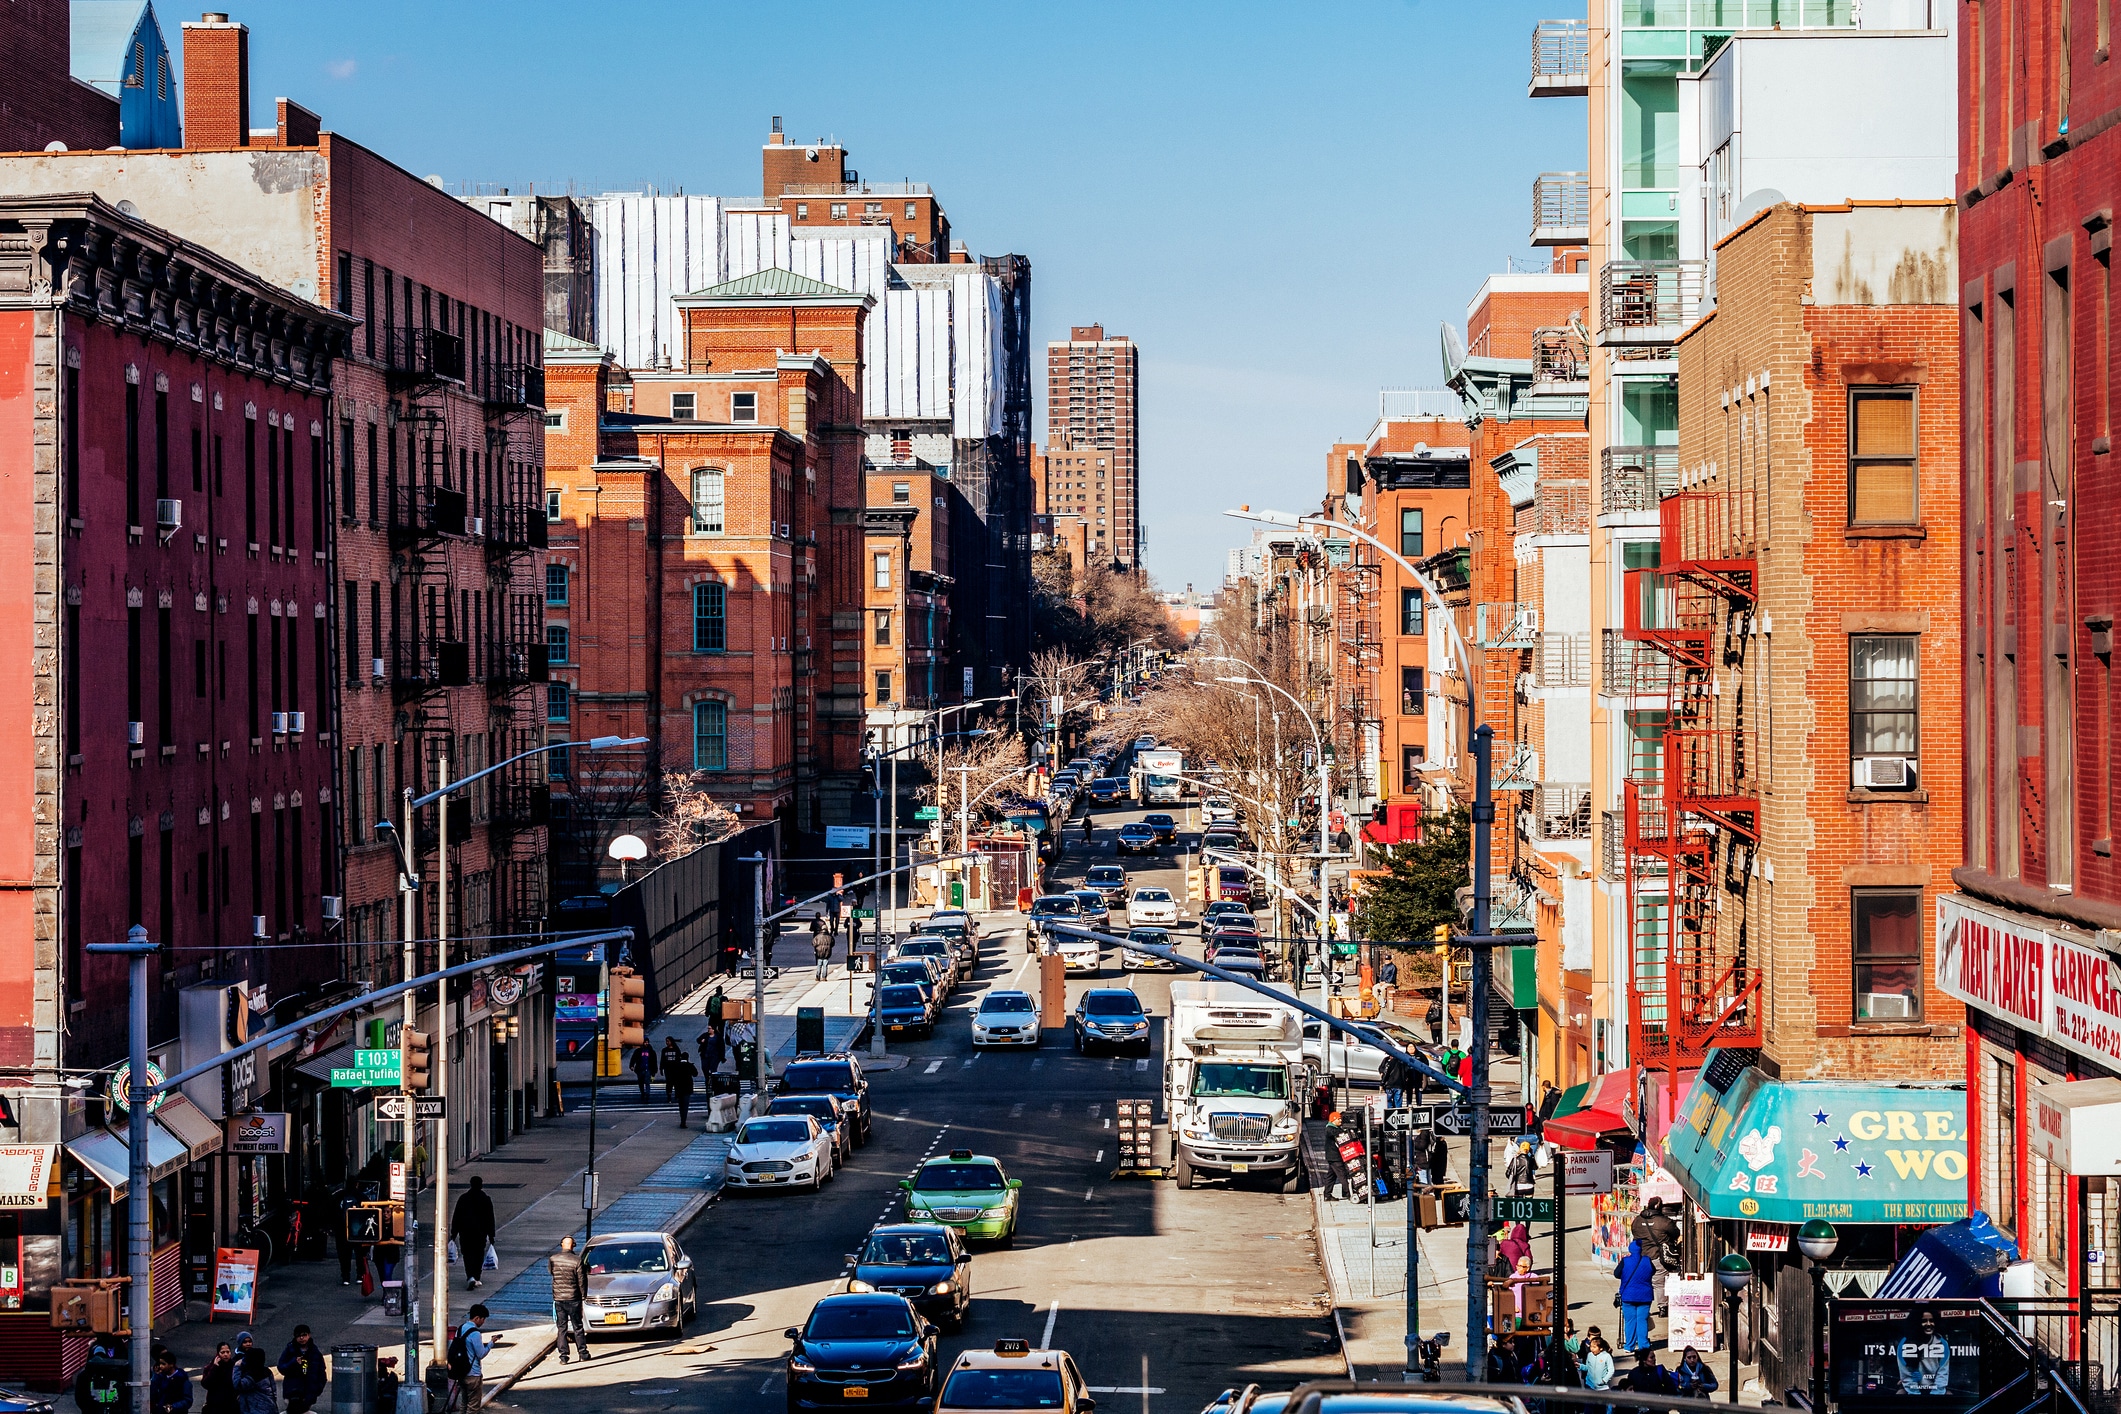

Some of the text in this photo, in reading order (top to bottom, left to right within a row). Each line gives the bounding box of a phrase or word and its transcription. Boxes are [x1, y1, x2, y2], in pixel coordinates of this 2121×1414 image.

[1959, 916, 1990, 1002] MEAT
[1991, 928, 2044, 1024] MARKET
[2051, 942, 2121, 1019] CARNICER
[2056, 1005, 2070, 1039] TEL.
[357, 1050, 399, 1066] E 103 St
[333, 1068, 400, 1080] Rafael Tufiño
[386, 1103, 437, 1113] ONE WAY
[1391, 1112, 1427, 1125] ONE WAY
[1443, 1114, 1518, 1127] ONE WAY
[239, 1126, 275, 1136] boost
[233, 1143, 279, 1151] PAYMENT CENTER
[1570, 1155, 1600, 1165] PARKING
[1797, 1148, 1826, 1181] 大
[1565, 1165, 1587, 1176] nytime
[1730, 1171, 1777, 1194] 大旺
[1497, 1201, 1549, 1219] E 103 St
[1742, 1201, 1756, 1212] 1631
[1884, 1203, 1968, 1218] THE BEST CHINESE
[5, 1270, 14, 1283] B
[1864, 1344, 1886, 1356] IT'S
[1888, 1345, 1897, 1356] A
[1901, 1343, 1945, 1358] 212
